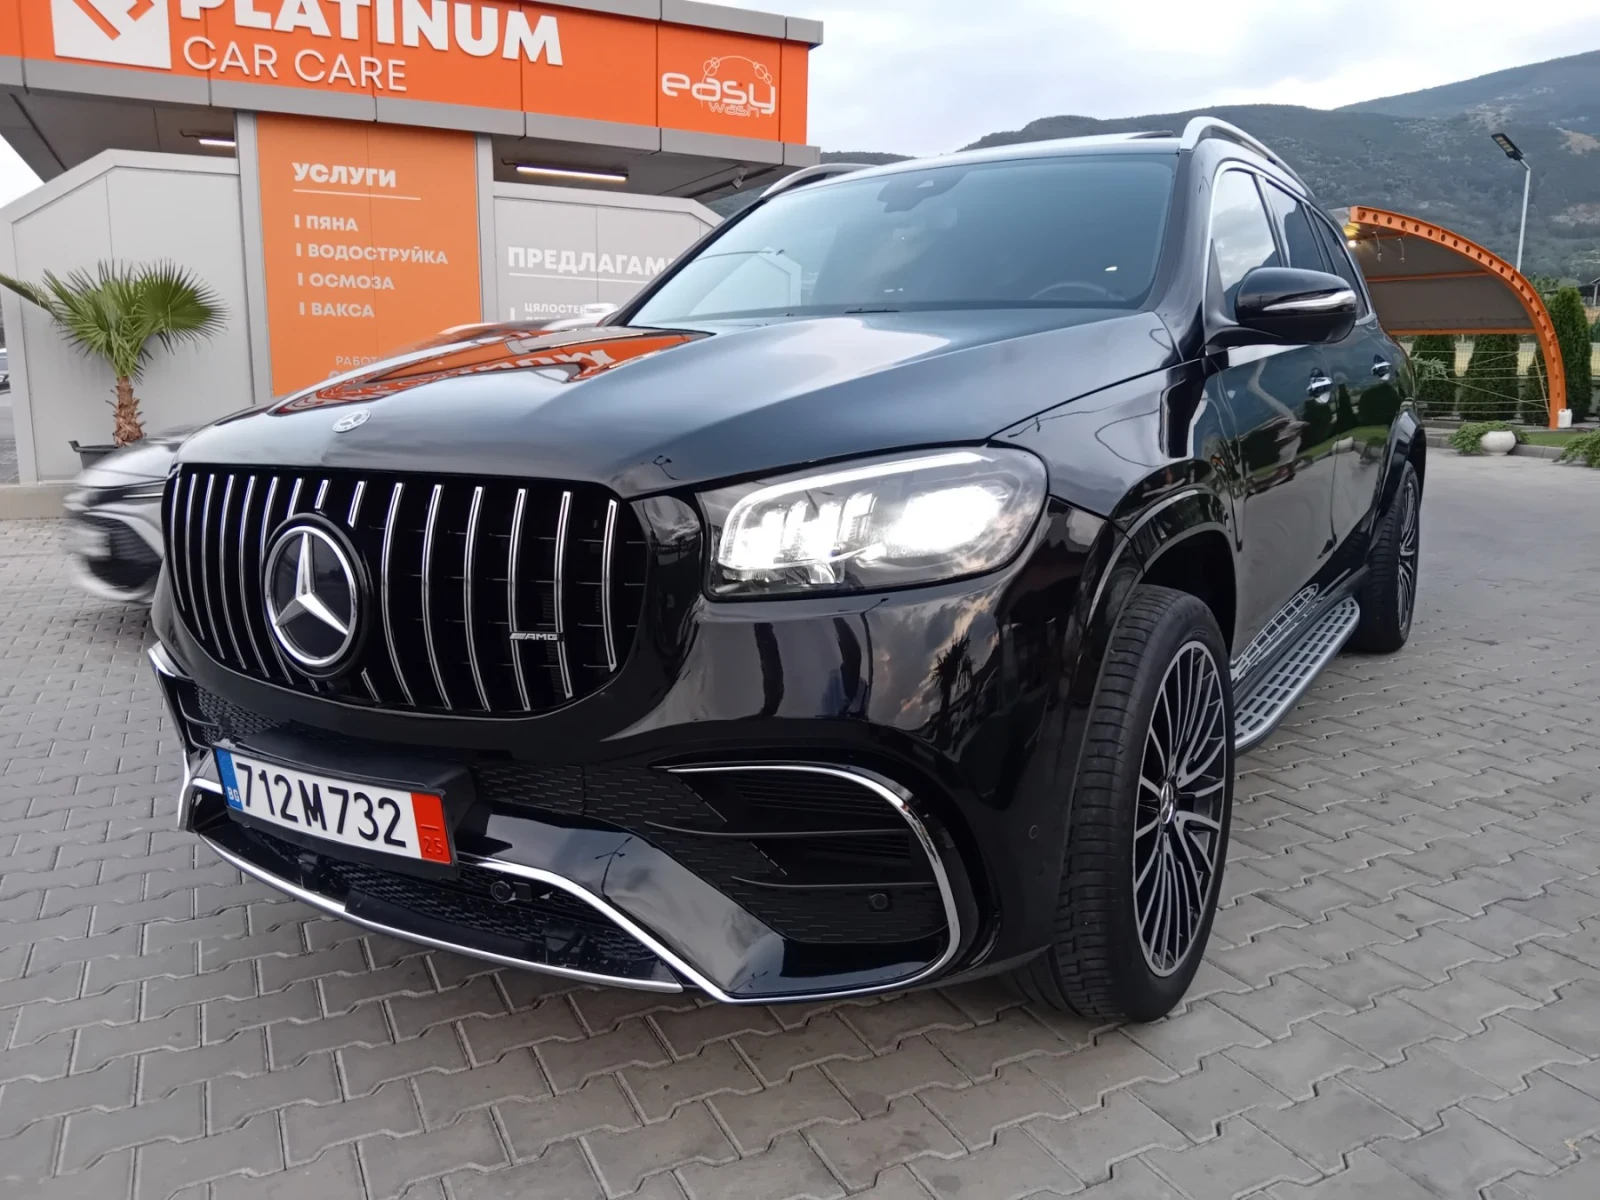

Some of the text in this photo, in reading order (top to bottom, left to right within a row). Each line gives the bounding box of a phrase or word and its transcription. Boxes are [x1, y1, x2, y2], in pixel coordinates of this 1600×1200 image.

[183, 36, 407, 92] CAR CARE
[661, 72, 776, 114] easy
[292, 162, 396, 188] УСЛУГИ
[306, 215, 359, 232] ПЯНА
[308, 243, 449, 265] ВОДОСТРУЙКА
[309, 273, 395, 290] ОСМОЗА
[311, 302, 375, 318] ВАКСА
[524, 632, 558, 641] AMG
[227, 786, 240, 803] BG
[236, 762, 407, 848] 712M732
[423, 836, 443, 855] 25
